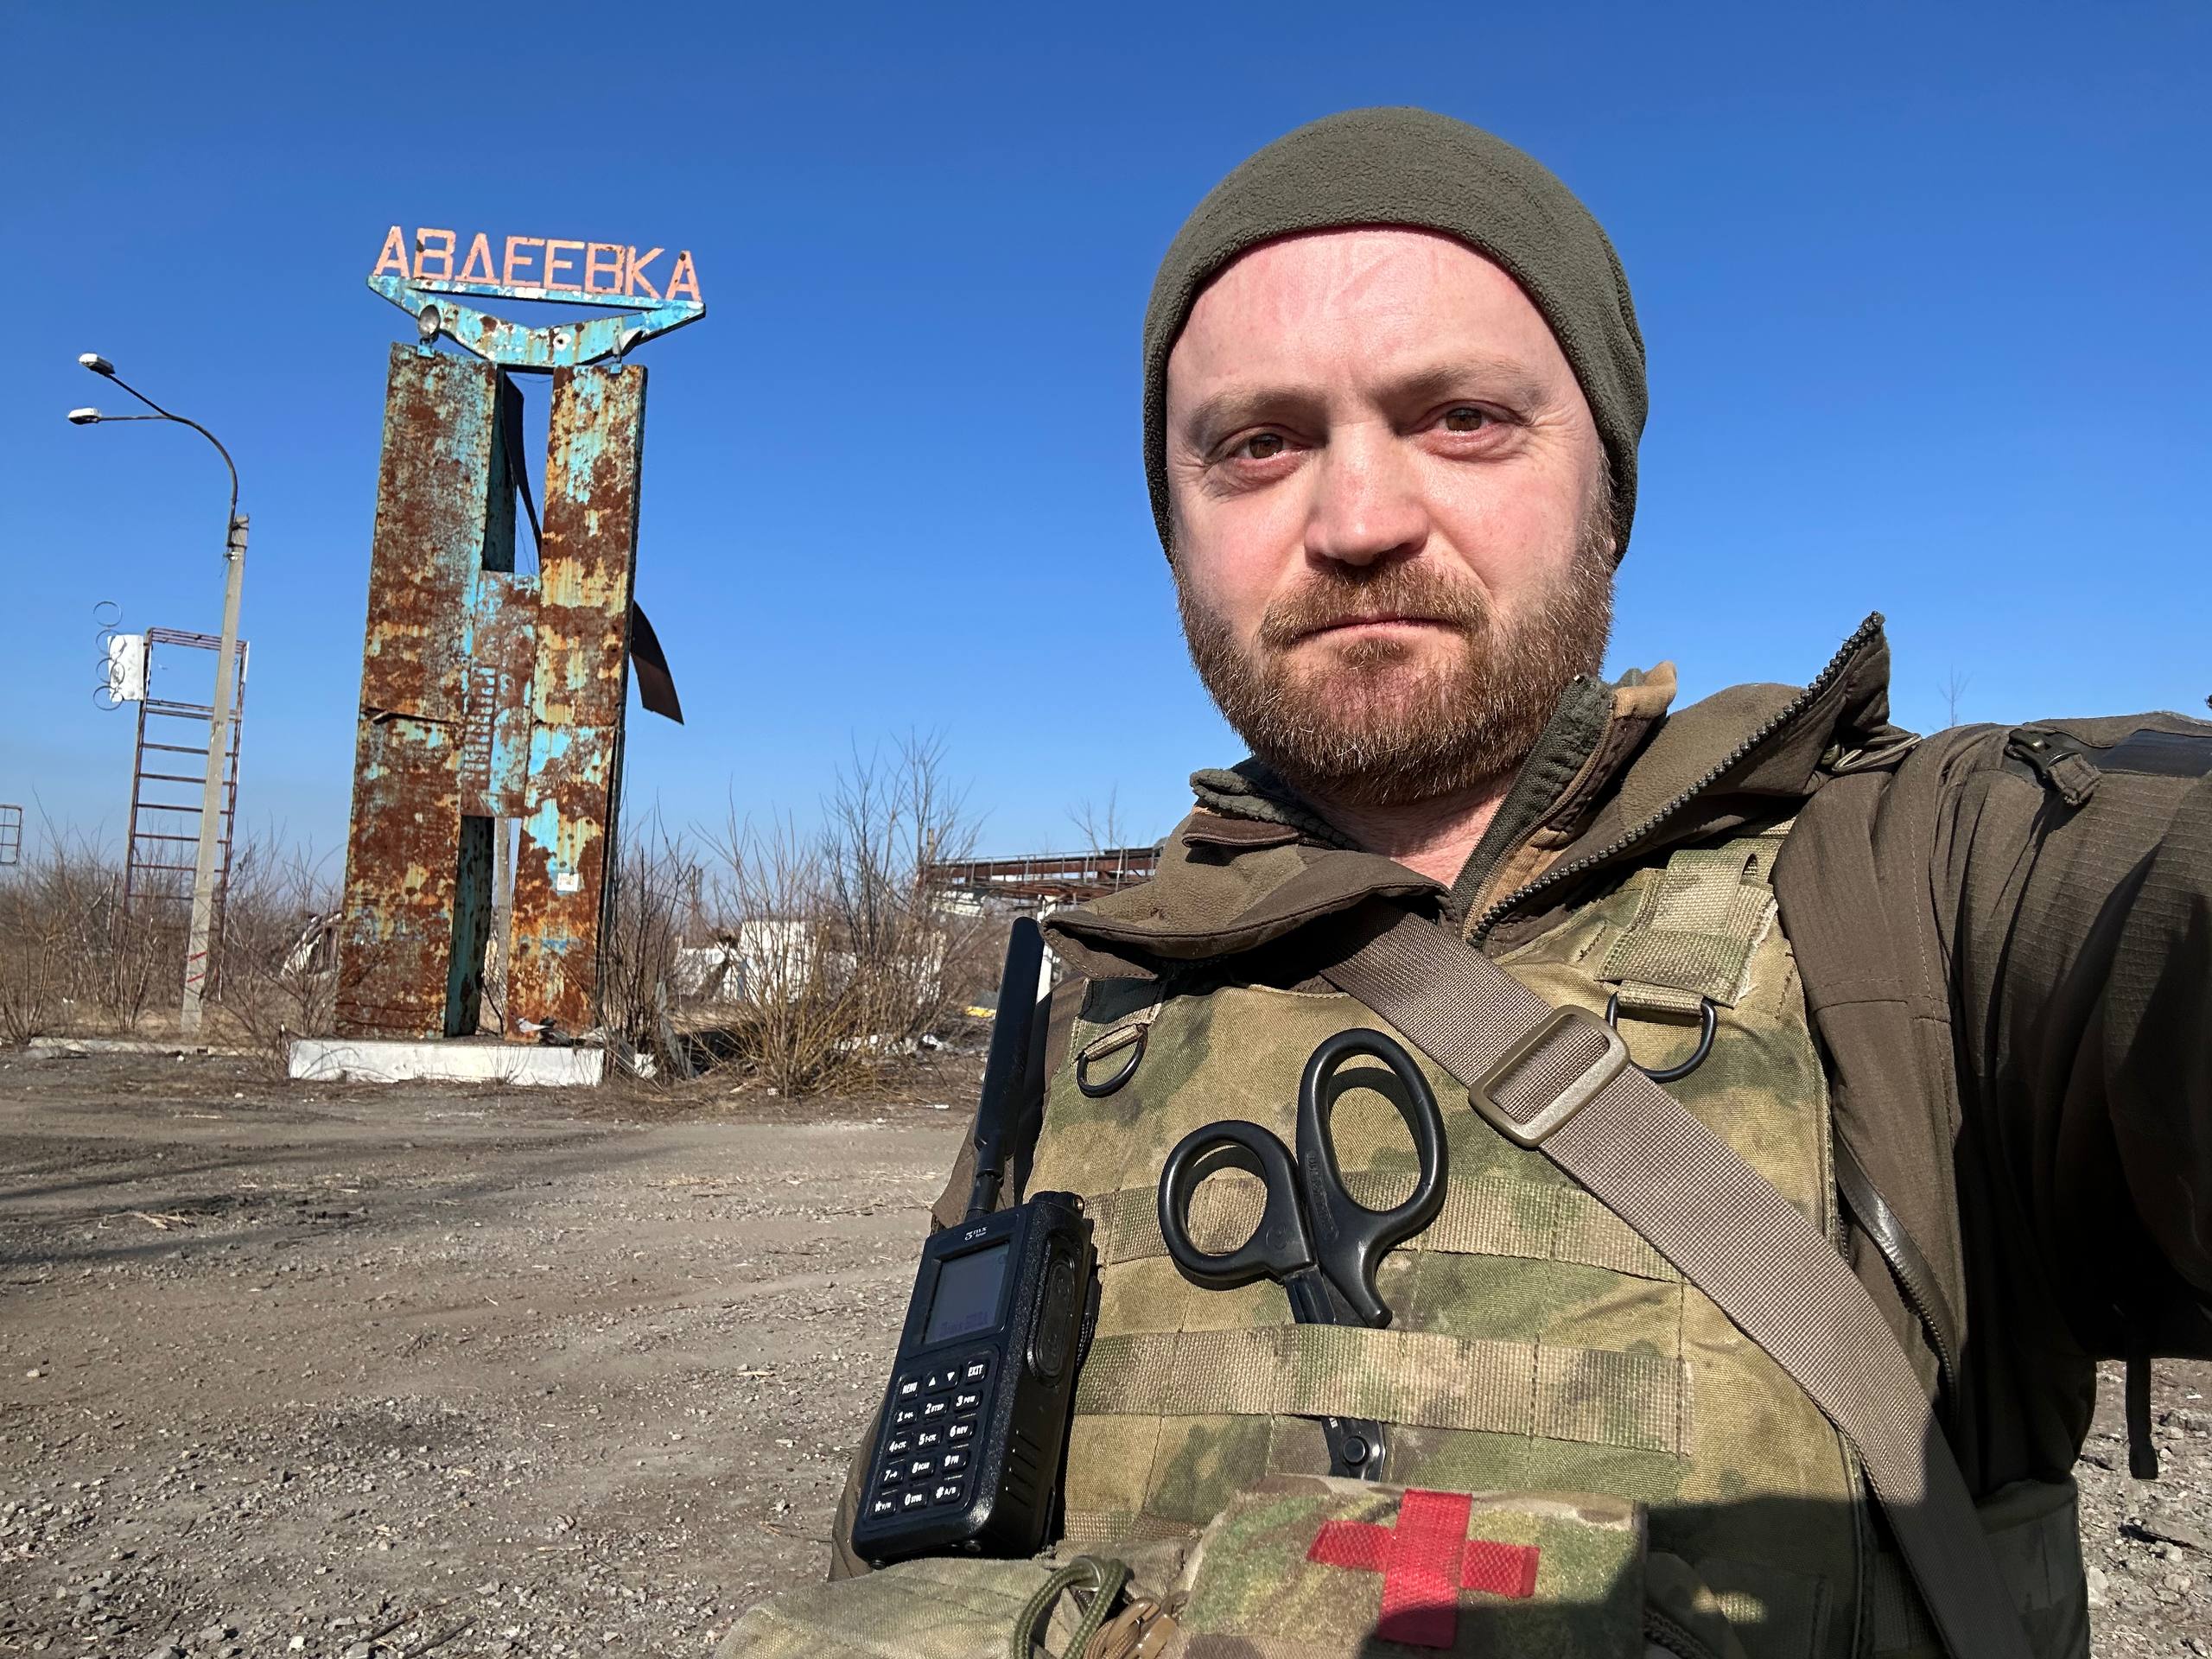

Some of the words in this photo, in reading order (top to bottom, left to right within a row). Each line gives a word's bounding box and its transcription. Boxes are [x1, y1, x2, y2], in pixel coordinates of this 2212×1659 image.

[372, 226, 702, 301] АВДЕЕВКА
[968, 1364, 983, 1377] EXIT
[902, 1382, 918, 1395] MENU
[956, 1395, 963, 1407] 3
[925, 1403, 931, 1414] 2
[897, 1411, 903, 1422] 1
[950, 1426, 957, 1438] 6
[918, 1433, 925, 1446] 5
[889, 1441, 895, 1452] 4
[944, 1455, 950, 1466] 9
[912, 1462, 918, 1473] 8
[884, 1469, 891, 1481] 7
[905, 1493, 911, 1506] 0
